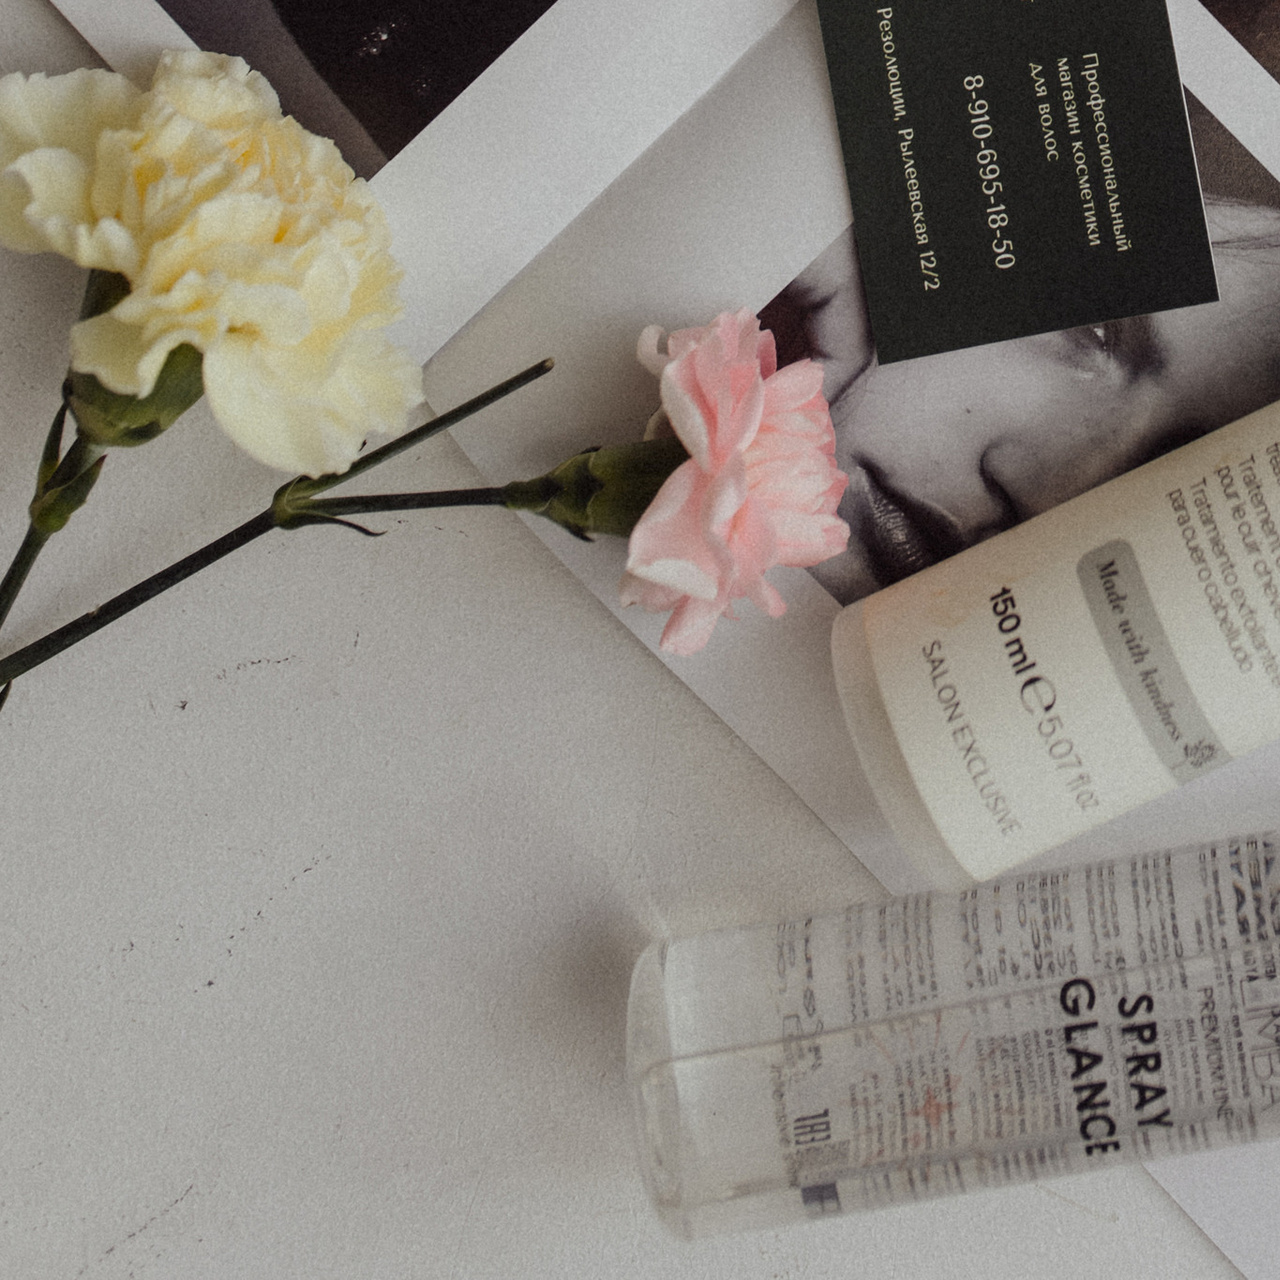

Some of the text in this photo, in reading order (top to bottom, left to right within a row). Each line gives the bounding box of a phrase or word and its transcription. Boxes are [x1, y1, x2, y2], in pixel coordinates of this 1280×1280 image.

[961, 72, 1017, 271] 8-910-695-18-50
[1026, 60, 1060, 162] для волос
[1055, 56, 1102, 247] магазин косметики
[1079, 51, 1133, 252] Профессиональный
[895, 127, 933, 246] Рылеевская
[916, 248, 941, 292] 12/2
[1186, 477, 1243, 587] Tratamiento
[1213, 463, 1241, 503] pour
[1228, 501, 1249, 522] le
[1234, 520, 1265, 559] cuir
[988, 584, 1024, 636] 150
[1164, 487, 1256, 673] para cuero cabelludo
[1001, 635, 1037, 676] ml
[1094, 557, 1187, 743] Made with kindness
[919, 638, 1021, 836] SALON EXCLUSIVE
[1034, 713, 1083, 773] 5.07
[1056, 975, 1121, 1157] GLANCE
[1115, 991, 1174, 1127] SPRAY
